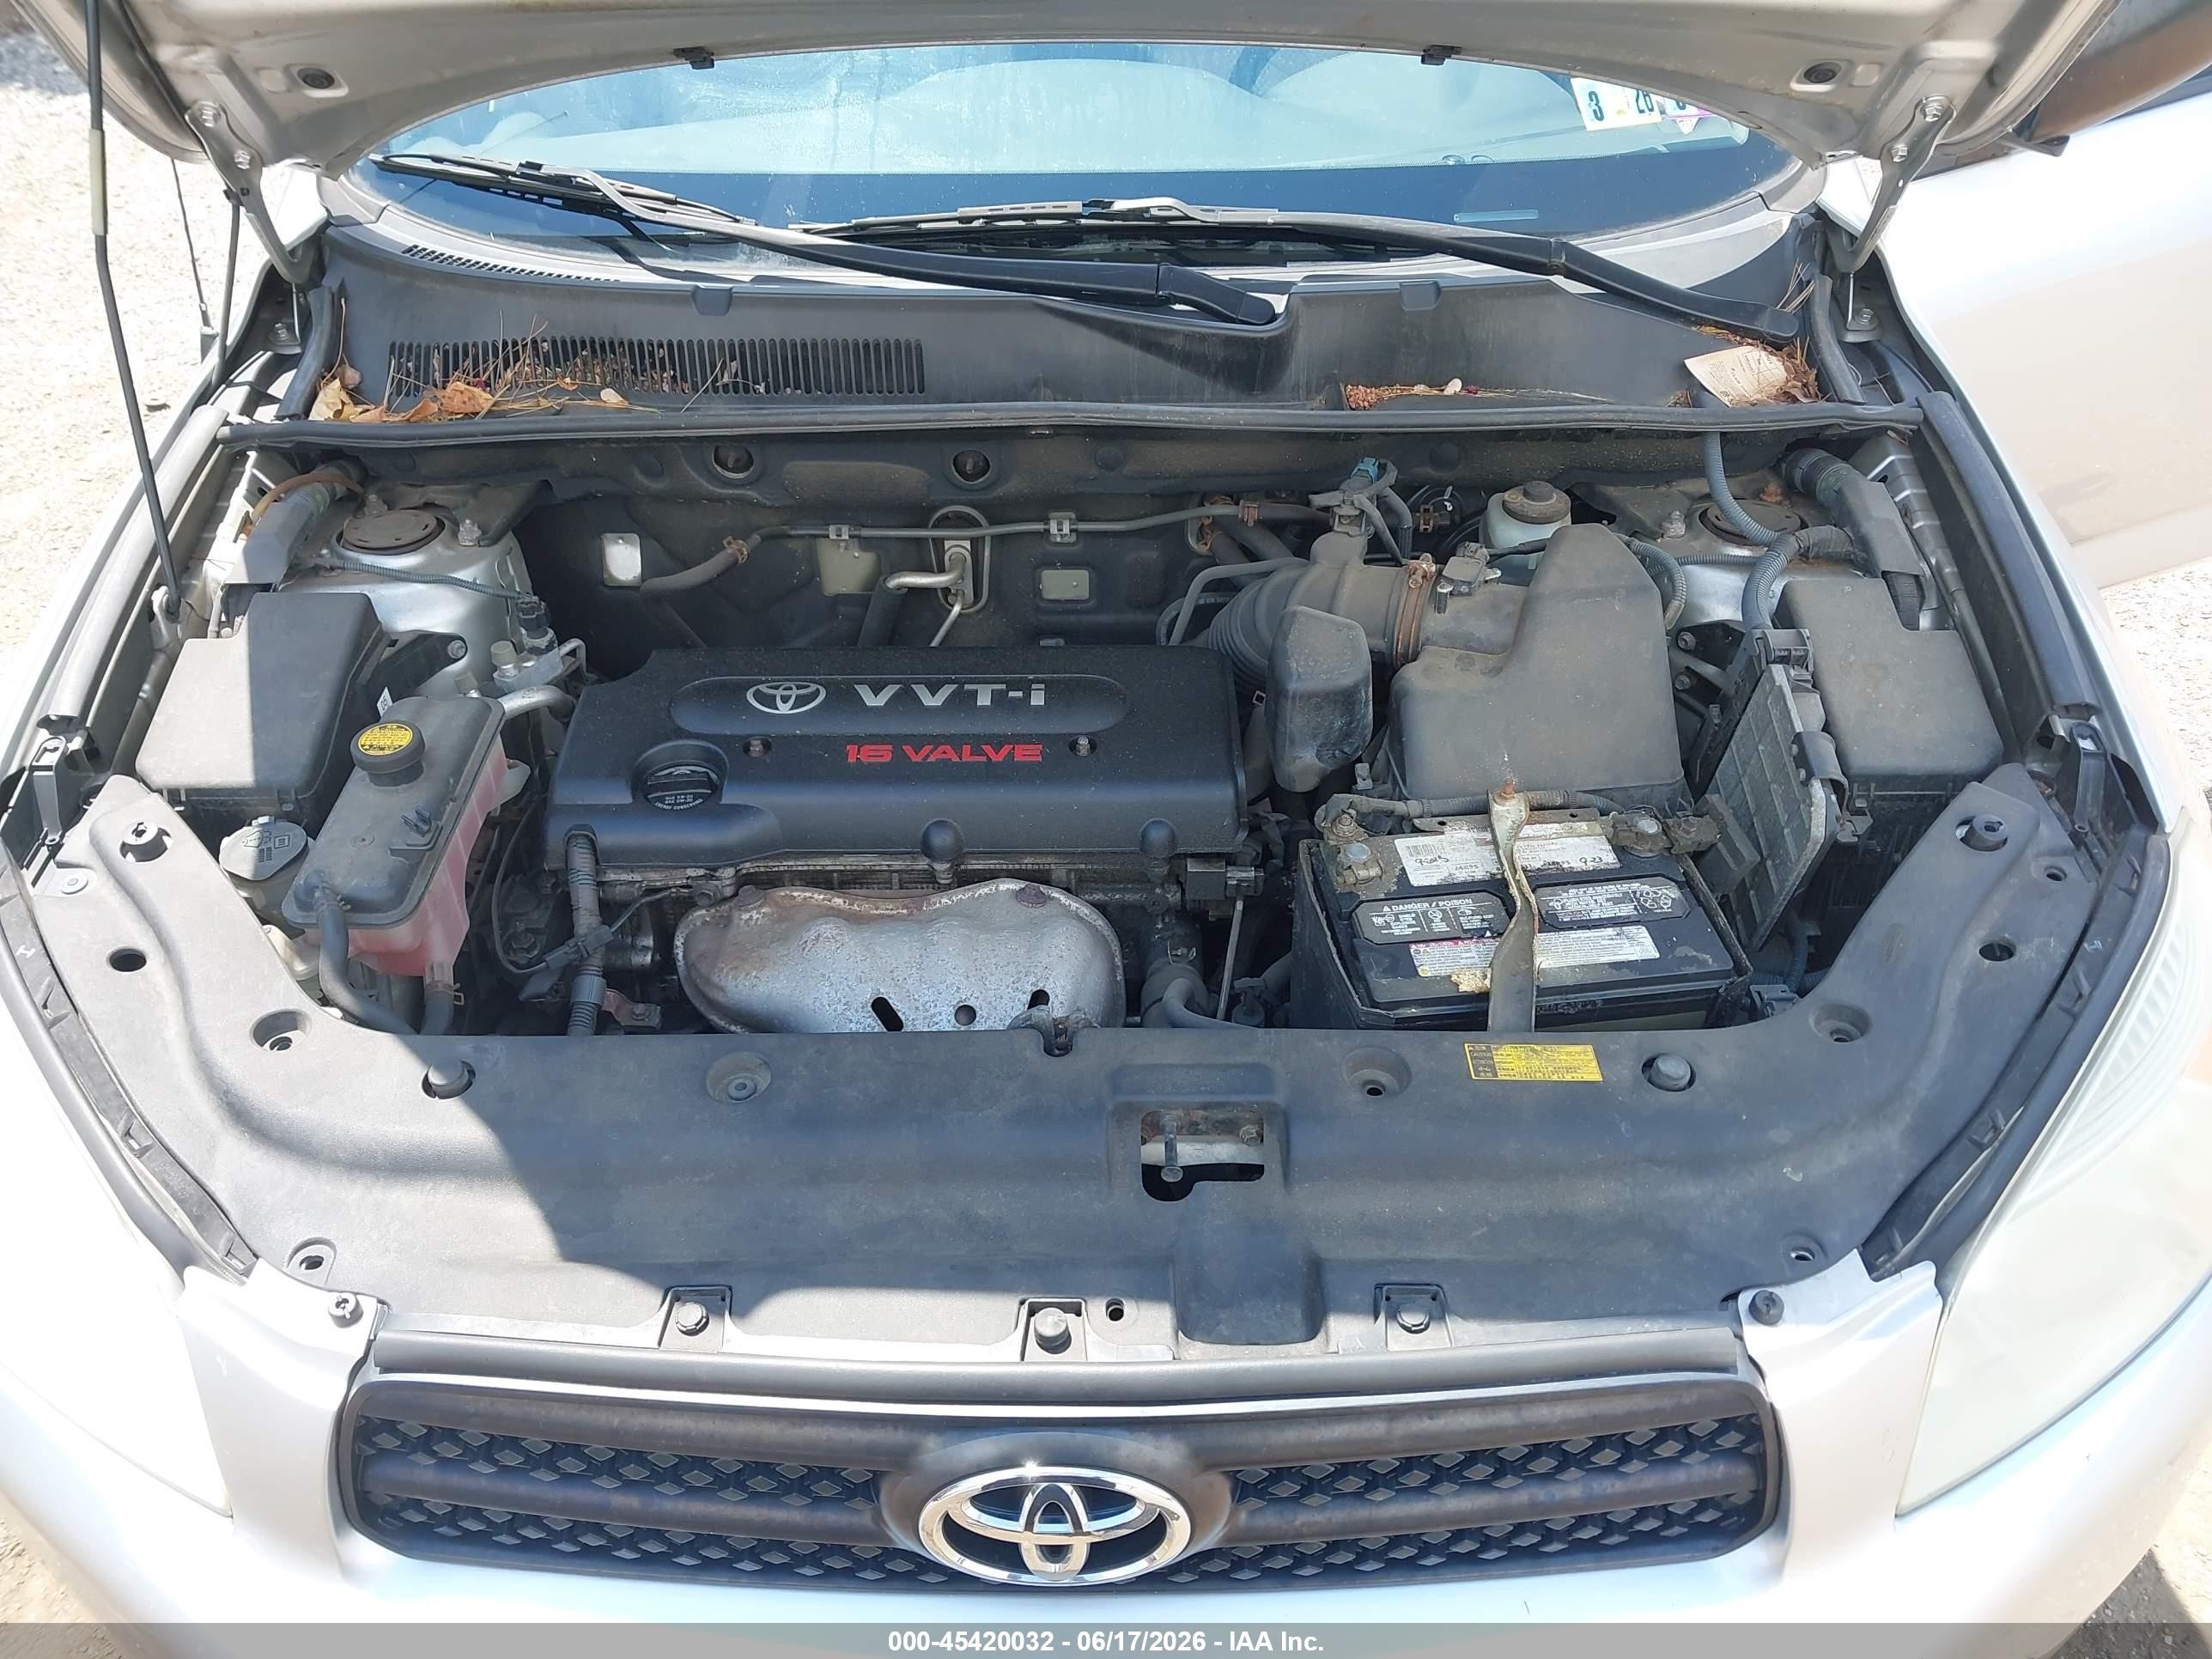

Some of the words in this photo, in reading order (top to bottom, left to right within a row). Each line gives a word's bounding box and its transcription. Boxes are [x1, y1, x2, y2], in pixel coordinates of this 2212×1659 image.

[1588, 90, 1605, 122] 3
[854, 684, 1046, 706] VVT-i
[848, 744, 892, 762] 16
[903, 744, 1042, 762] VALVE
[1391, 902, 1430, 911] DANGER
[1438, 898, 1473, 908] POISON
